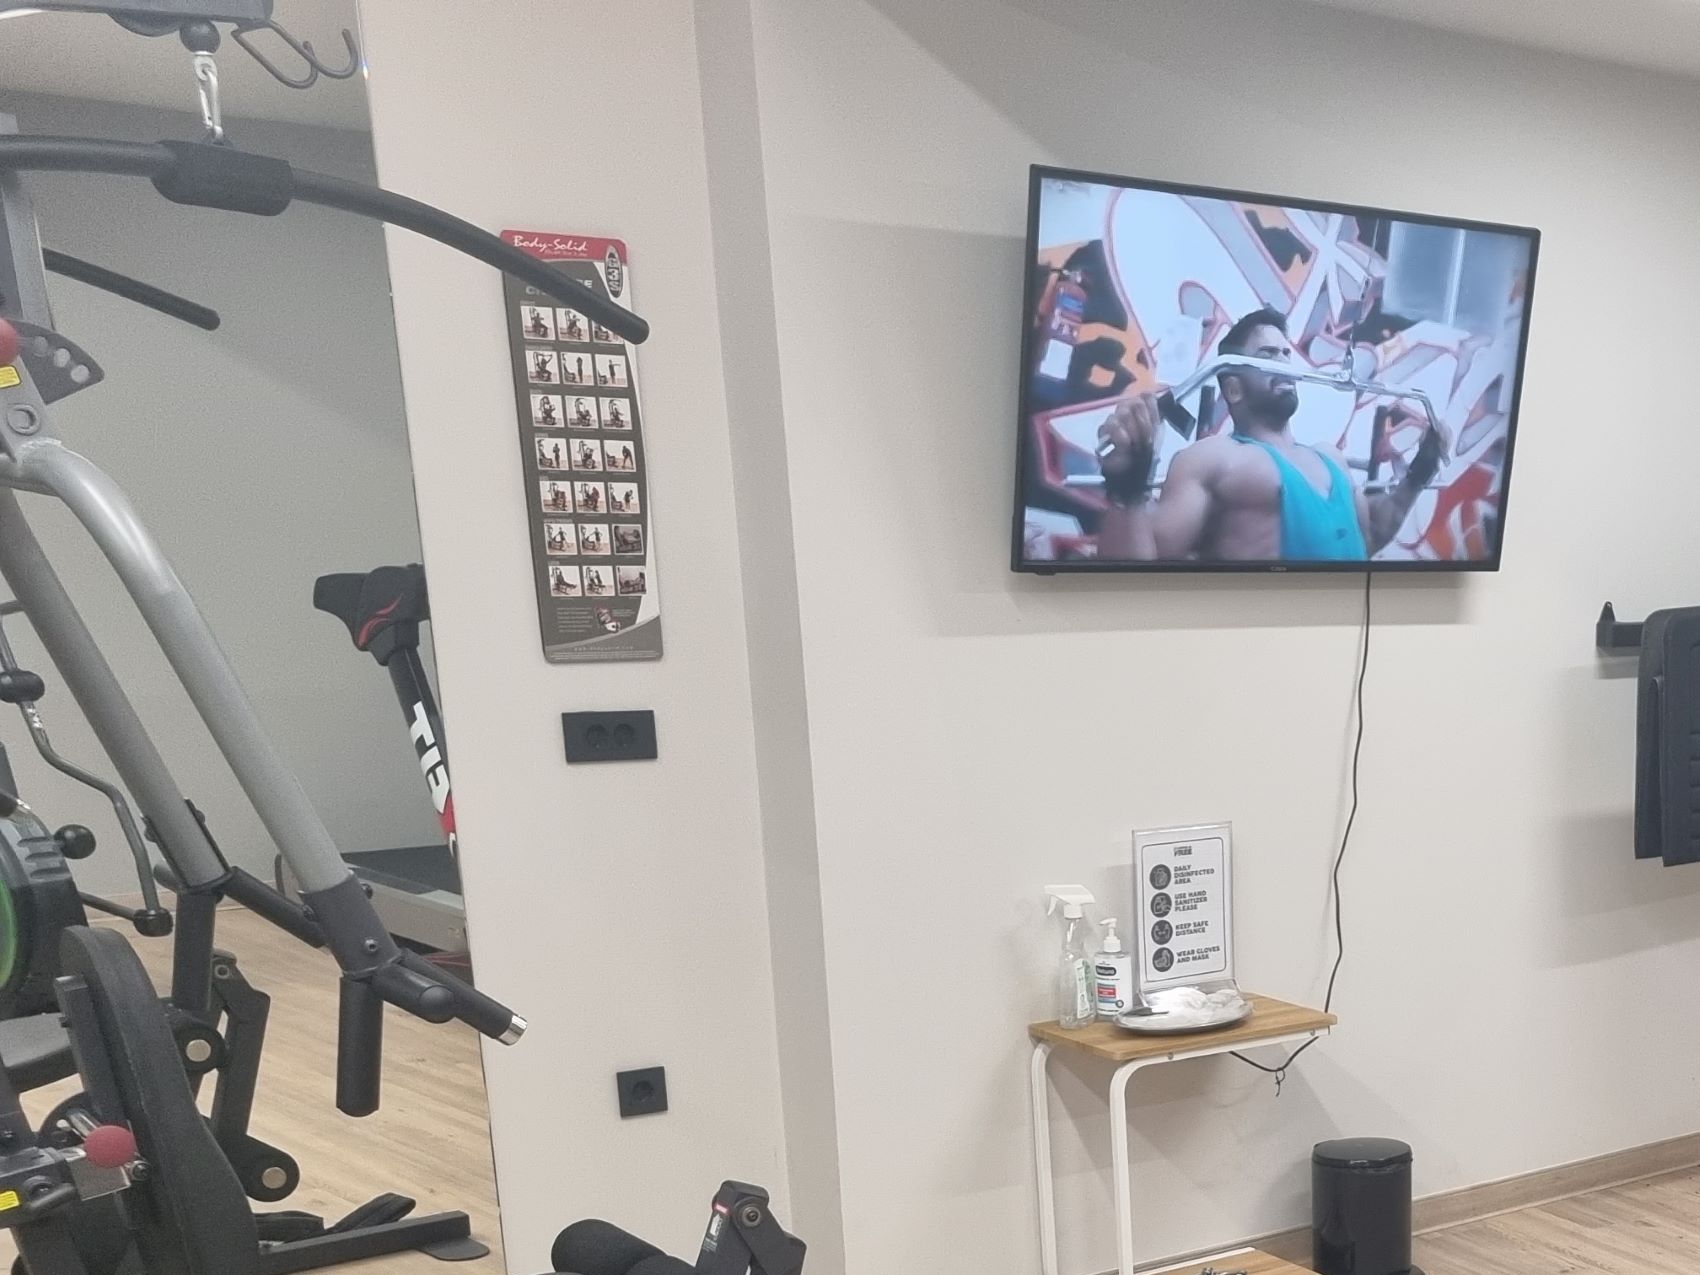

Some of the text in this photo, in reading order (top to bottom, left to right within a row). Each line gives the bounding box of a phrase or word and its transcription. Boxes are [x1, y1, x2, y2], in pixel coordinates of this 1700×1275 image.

[513, 234, 589, 253] Body-Solid
[1174, 864, 1192, 872] DAILY
[1174, 868, 1215, 879] DISINFECTED
[1174, 890, 1207, 900] USE HAND
[1174, 896, 1208, 906] SANITIZER
[1175, 904, 1198, 912] PLEASE
[1175, 922, 1192, 930] KEEP
[1175, 927, 1206, 937] DISTANCE
[1176, 946, 1220, 957] WEAR GLOVES
[1177, 956, 1191, 964] AND
